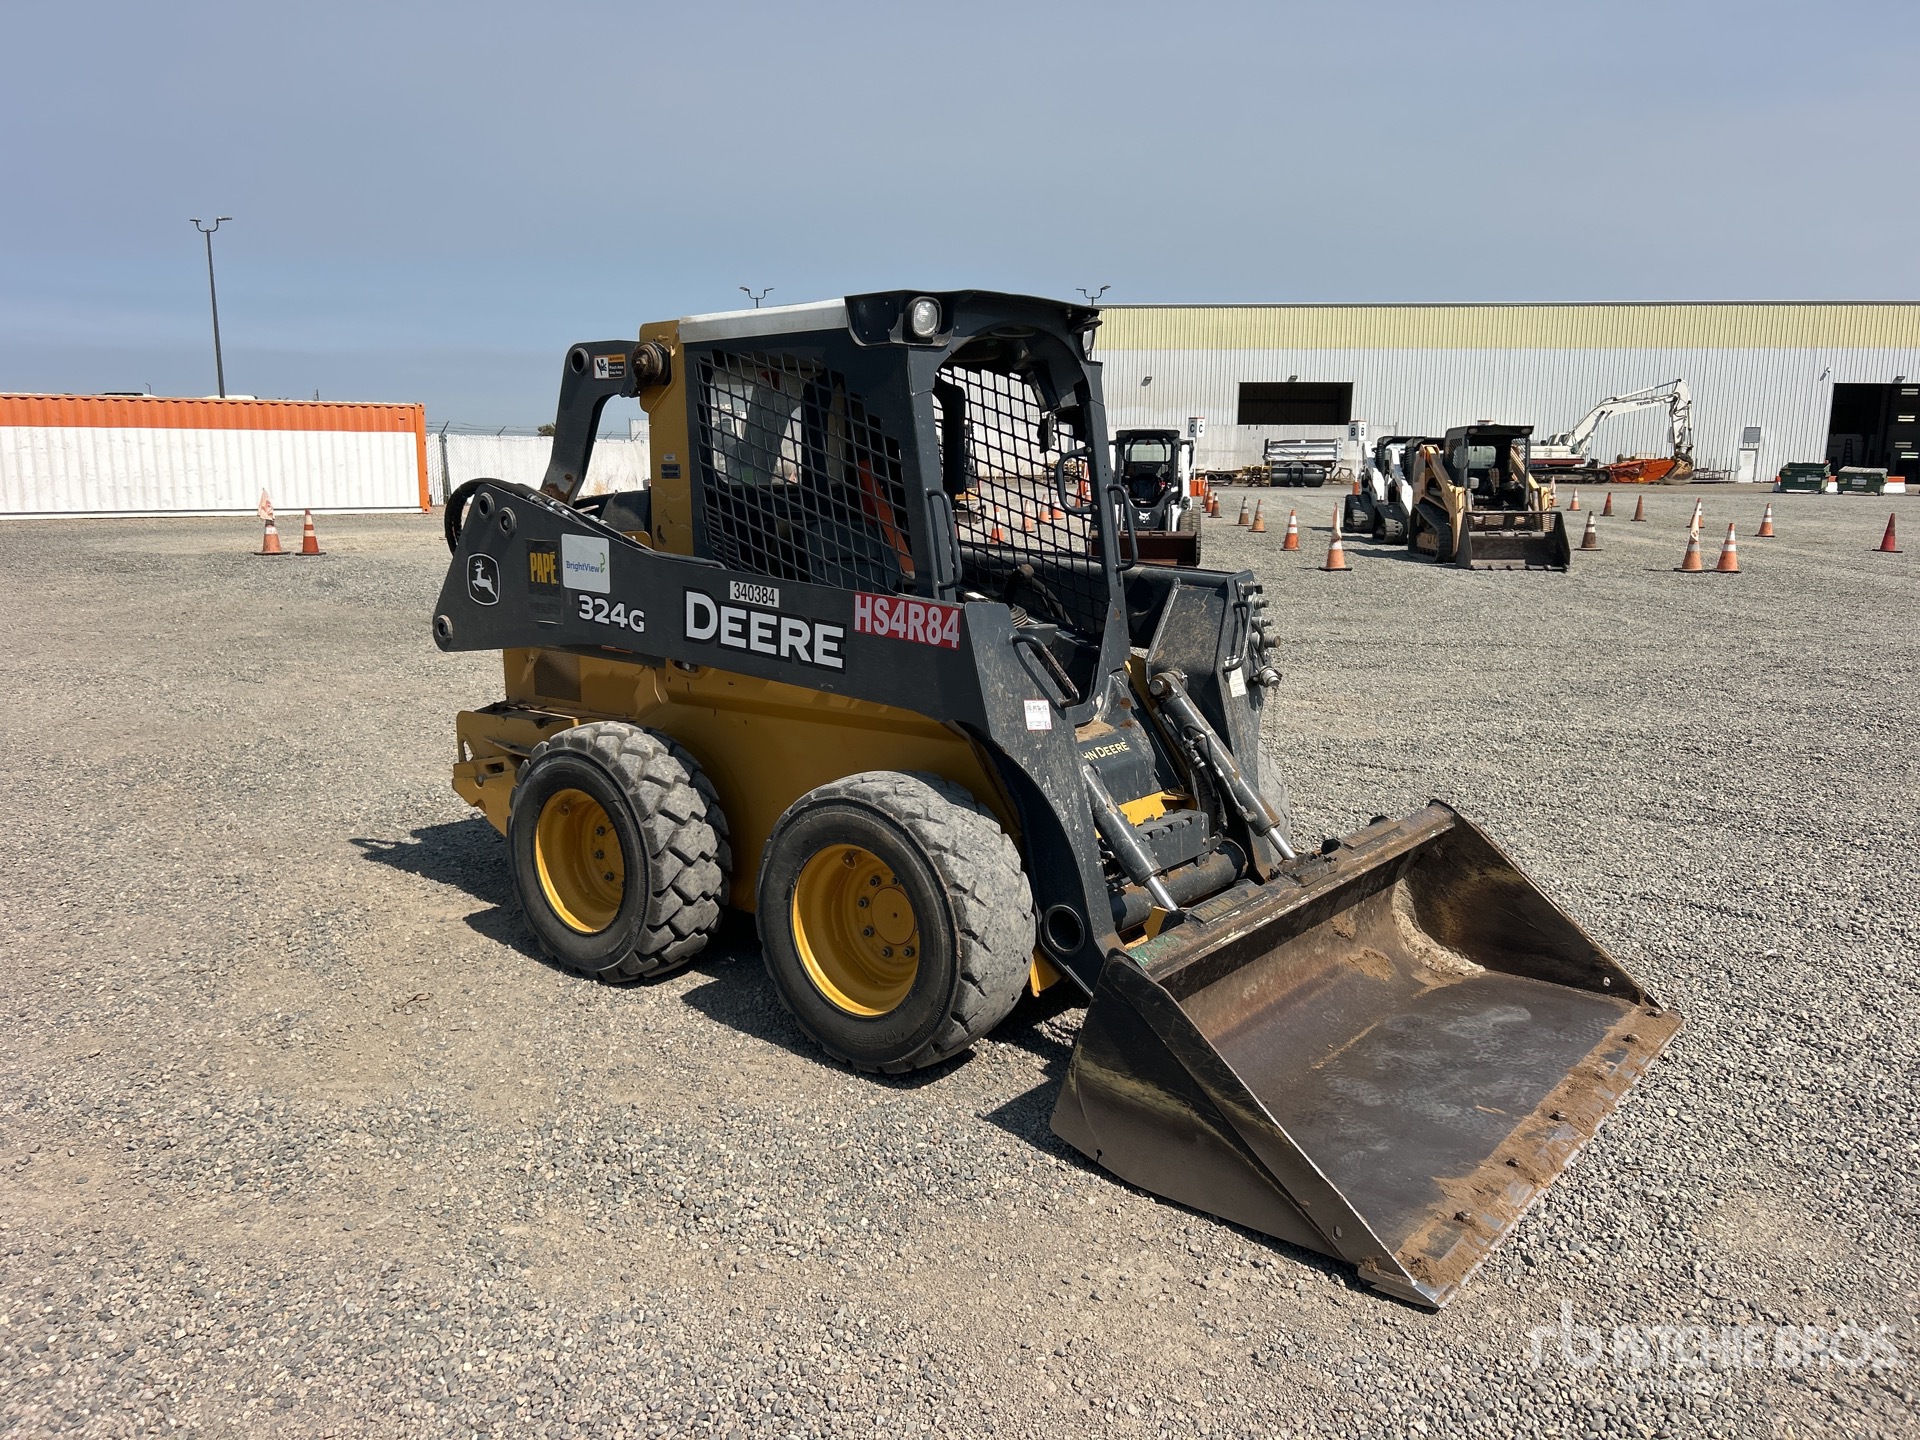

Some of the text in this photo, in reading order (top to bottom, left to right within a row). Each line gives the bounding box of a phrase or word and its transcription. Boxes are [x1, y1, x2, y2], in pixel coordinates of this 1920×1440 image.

[1190, 424, 1195, 433] C
[1350, 427, 1356, 437] B
[566, 560, 600, 574] BrightView
[733, 582, 776, 606] 340384
[578, 594, 645, 633] 324G
[854, 594, 960, 648] HS4R84
[685, 590, 844, 669] DEERE
[1094, 741, 1130, 758] DEERE
